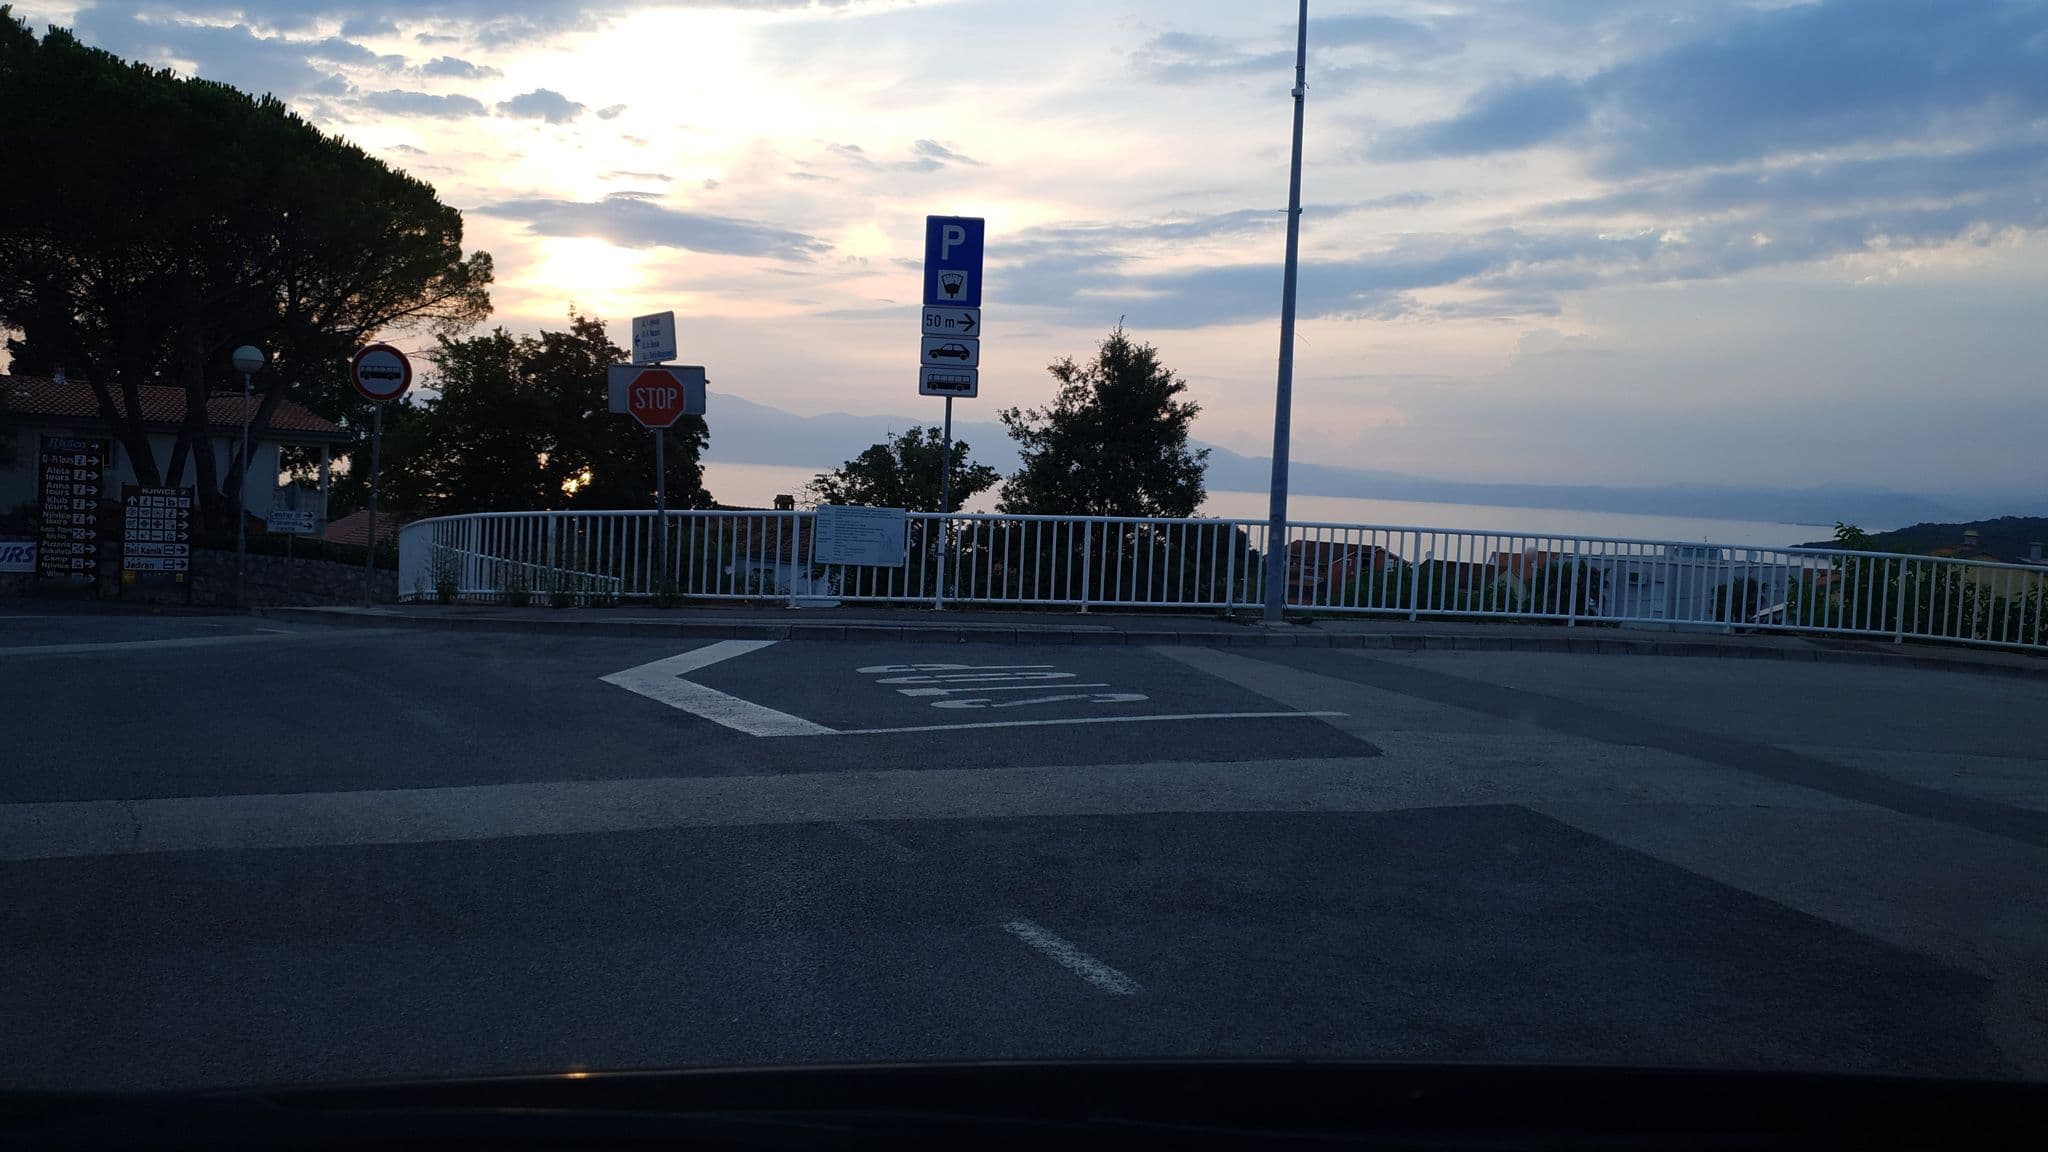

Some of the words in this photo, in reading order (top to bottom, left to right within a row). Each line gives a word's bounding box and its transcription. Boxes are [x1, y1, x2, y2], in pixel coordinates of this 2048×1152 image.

[941, 225, 966, 260] P
[926, 314, 942, 328] 50
[945, 319, 955, 328] m
[635, 387, 677, 409] STOP
[125, 561, 155, 569] Jadran
